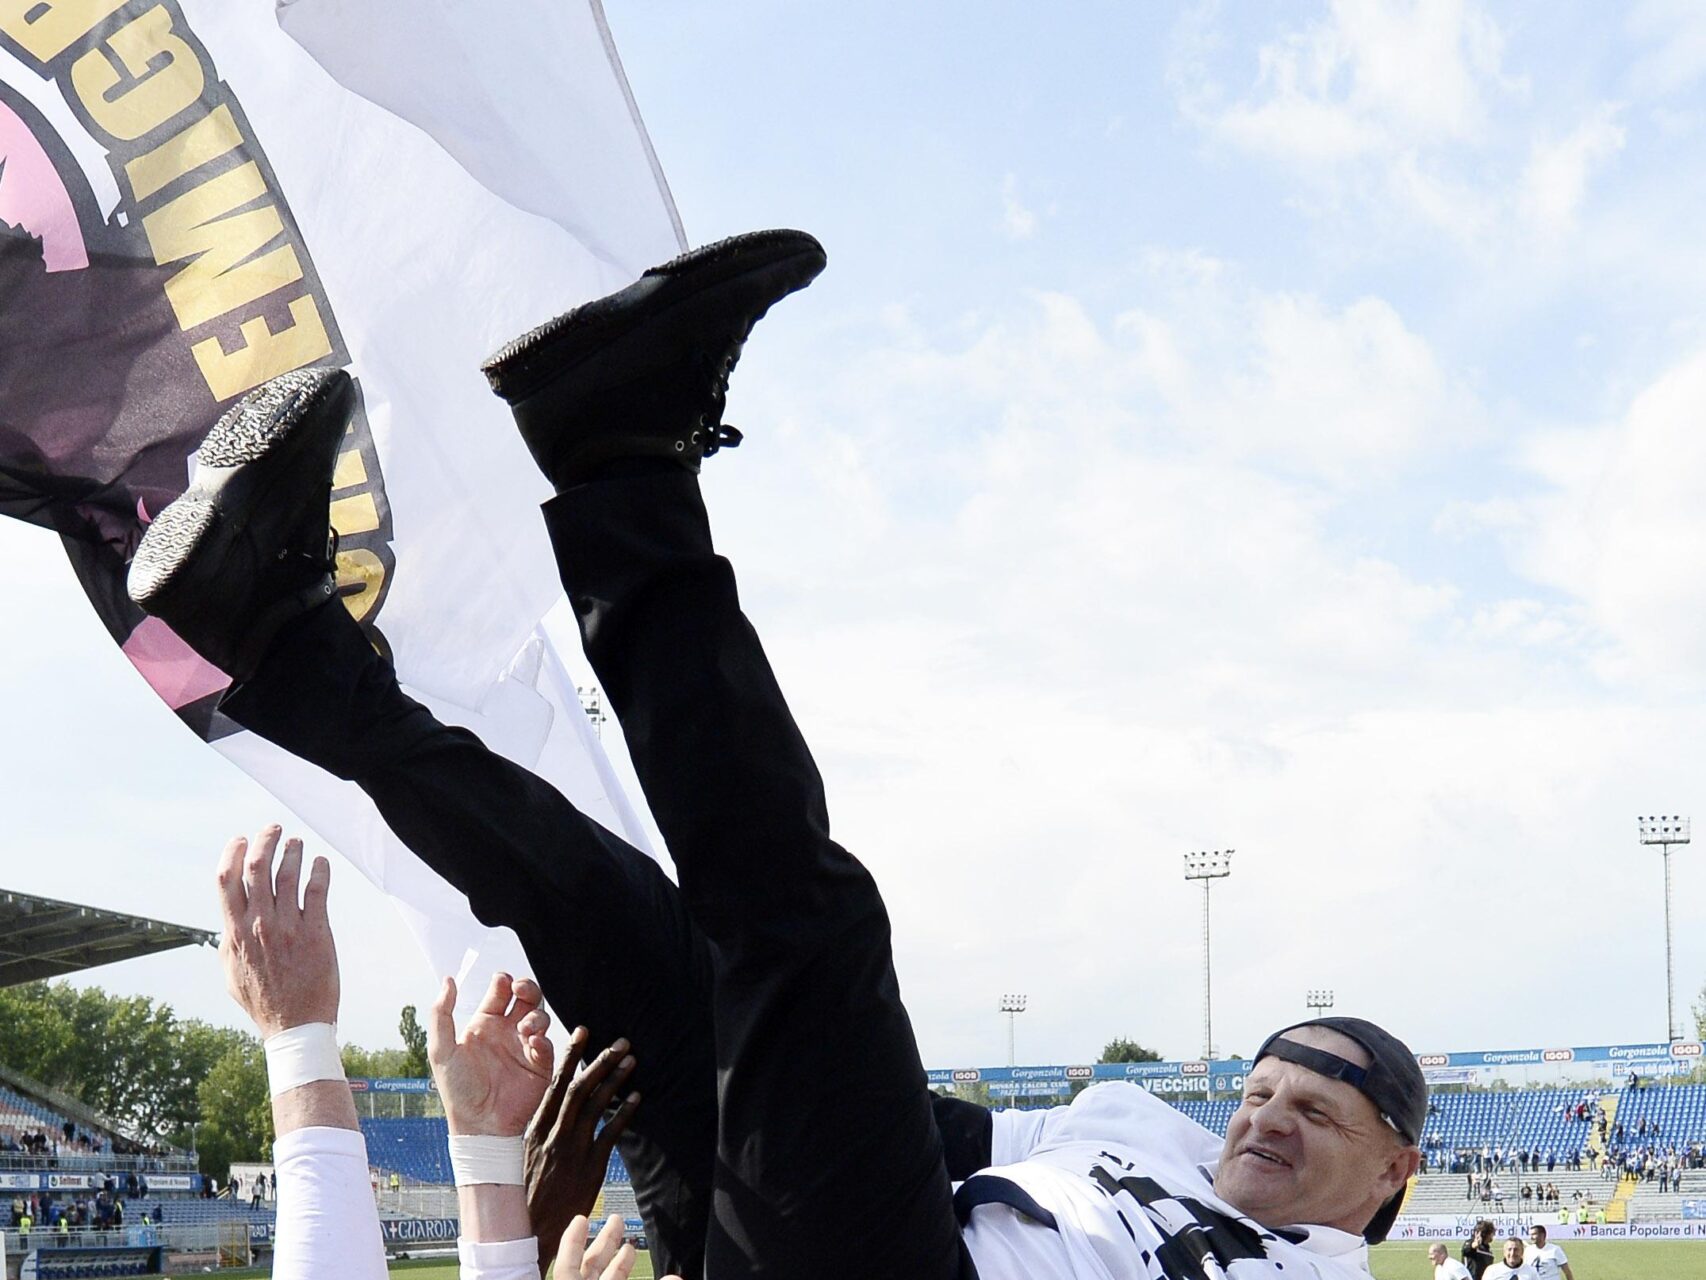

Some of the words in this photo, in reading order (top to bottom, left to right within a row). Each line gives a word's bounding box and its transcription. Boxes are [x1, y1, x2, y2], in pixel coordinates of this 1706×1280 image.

[1483, 1051, 1539, 1064] Gorgonzola
[1545, 1052, 1570, 1061] IGOR
[1609, 1045, 1667, 1059] Gorgonzola
[1673, 1045, 1700, 1055] IGOR
[1421, 1057, 1445, 1065] IGOR
[1012, 1067, 1062, 1079] Gorgonzola
[1068, 1068, 1090, 1076] IGOR
[1126, 1064, 1177, 1075] Gorgonzola
[1183, 1065, 1206, 1073] IGOR
[955, 1072, 977, 1080] IGOR
[374, 1080, 425, 1091] Gorgonzola
[1142, 1076, 1210, 1092] VECCHIO
[1418, 1226, 1452, 1237] Banca
[1511, 1225, 1519, 1237] di
[1590, 1225, 1626, 1237] Banca
[1629, 1224, 1681, 1238] Popolare
[1684, 1224, 1695, 1236] di
